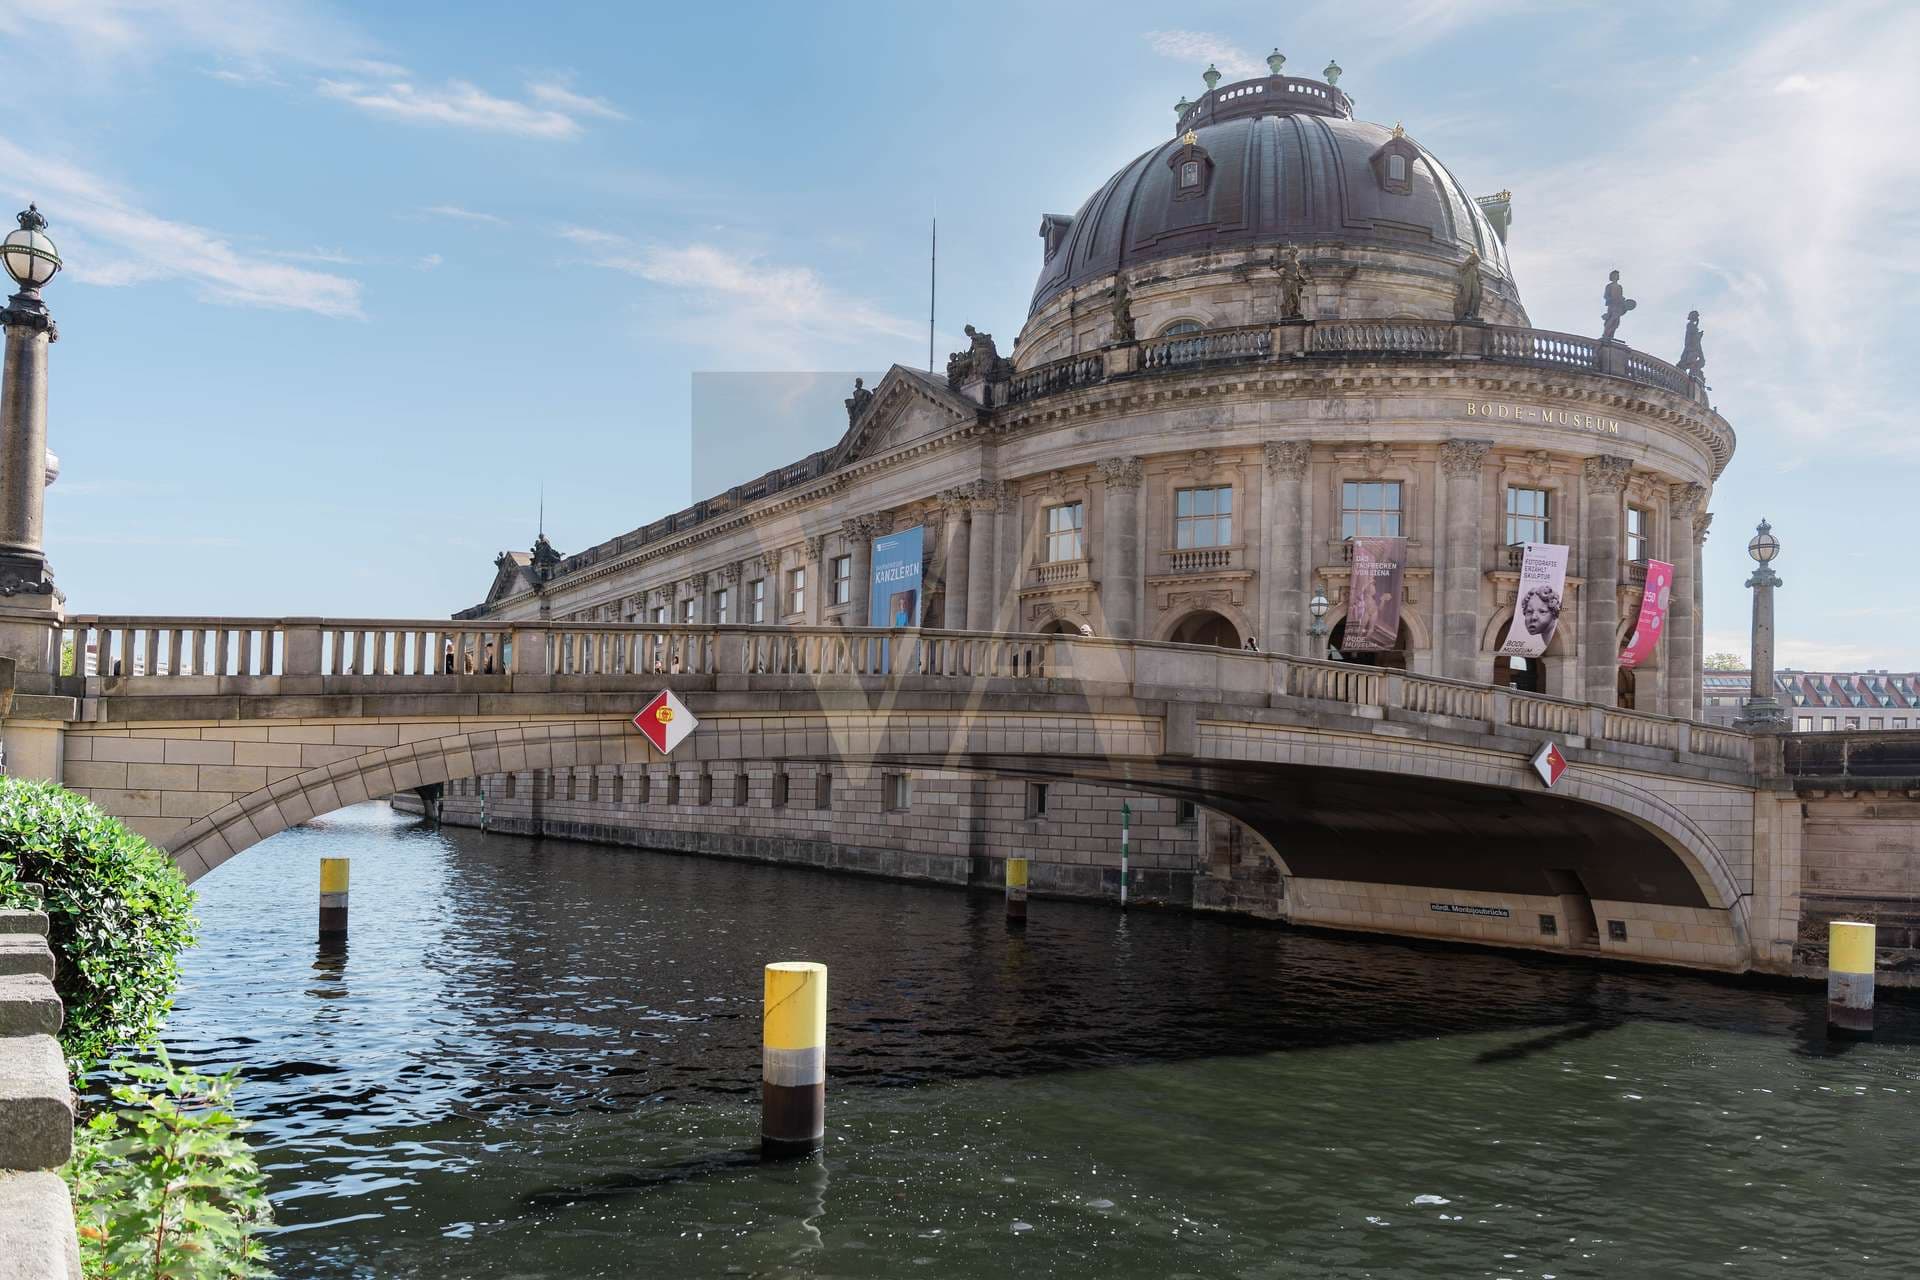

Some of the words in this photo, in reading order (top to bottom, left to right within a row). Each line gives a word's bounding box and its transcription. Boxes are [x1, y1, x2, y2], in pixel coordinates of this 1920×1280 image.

[1467, 402, 1620, 434] BODE-MUSEUM
[875, 562, 920, 584] KANZLERIN
[1525, 559, 1557, 567] FOTOGRAFIE
